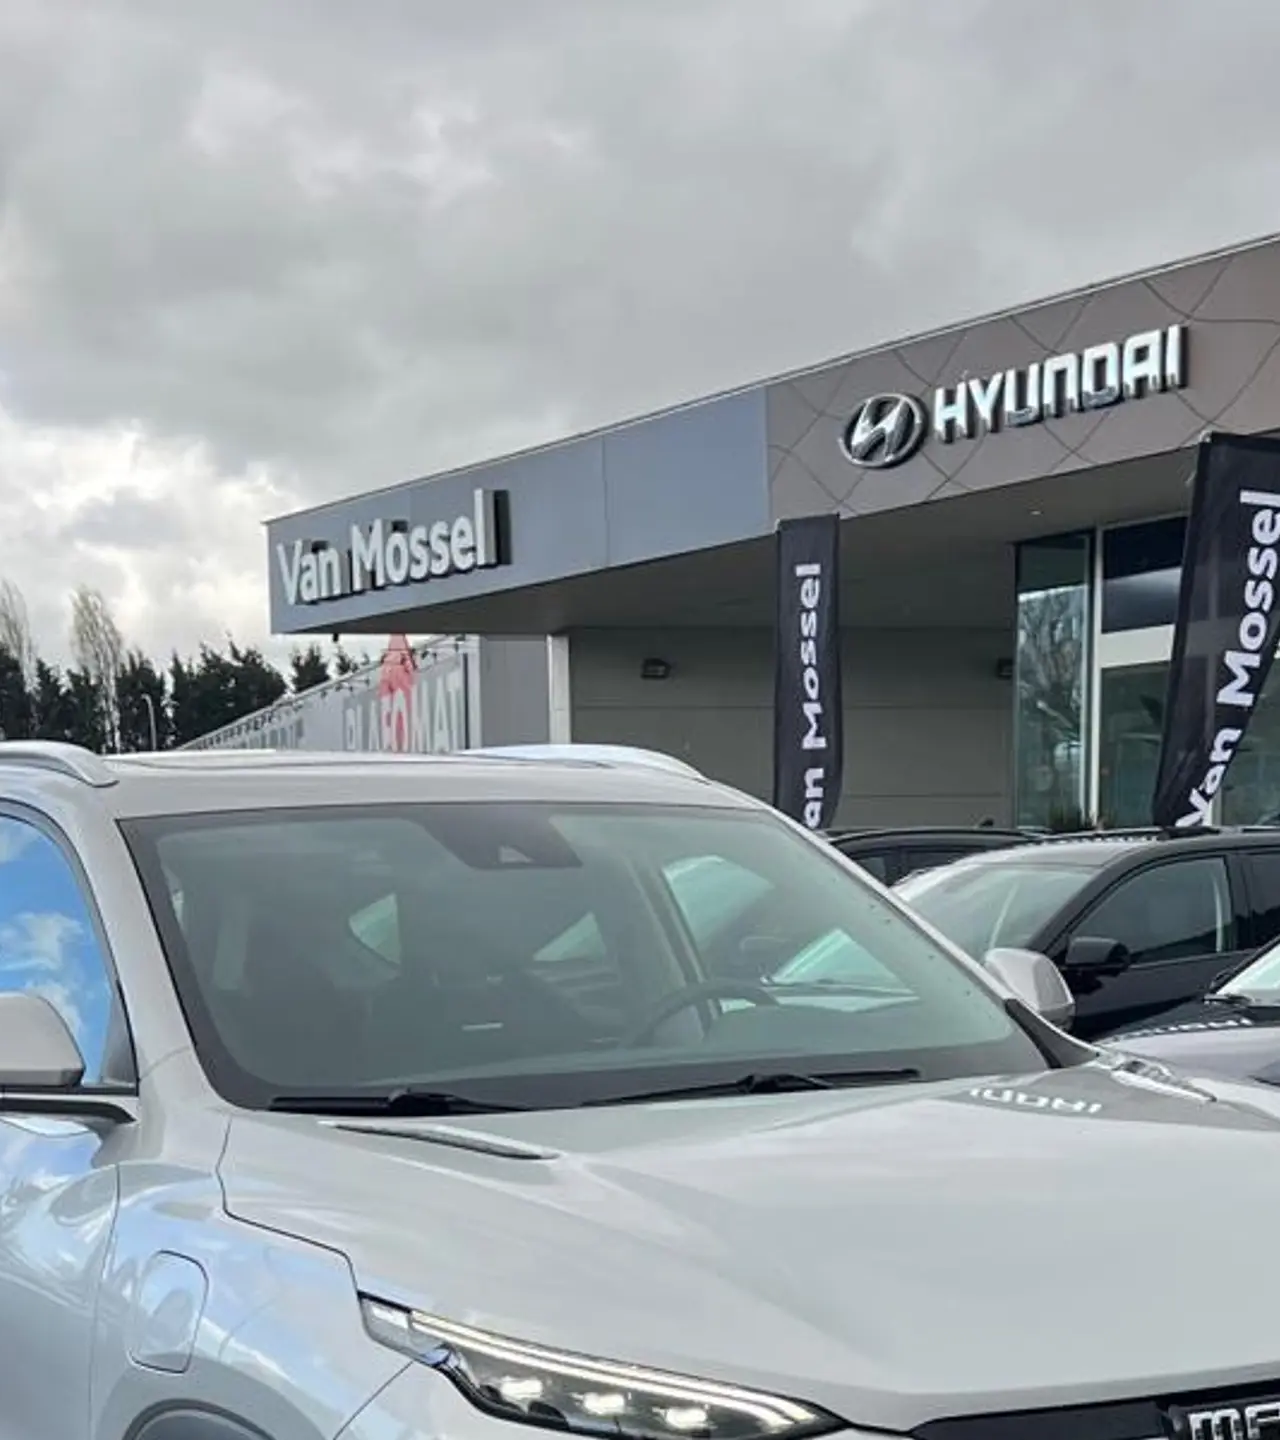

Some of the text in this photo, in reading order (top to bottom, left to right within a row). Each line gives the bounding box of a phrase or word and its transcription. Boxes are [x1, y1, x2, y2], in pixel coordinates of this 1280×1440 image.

[932, 325, 1184, 440] HYUNDAI
[275, 487, 490, 605] Van Mossel
[795, 563, 827, 830] an Mossel
[1175, 727, 1243, 828] Van
